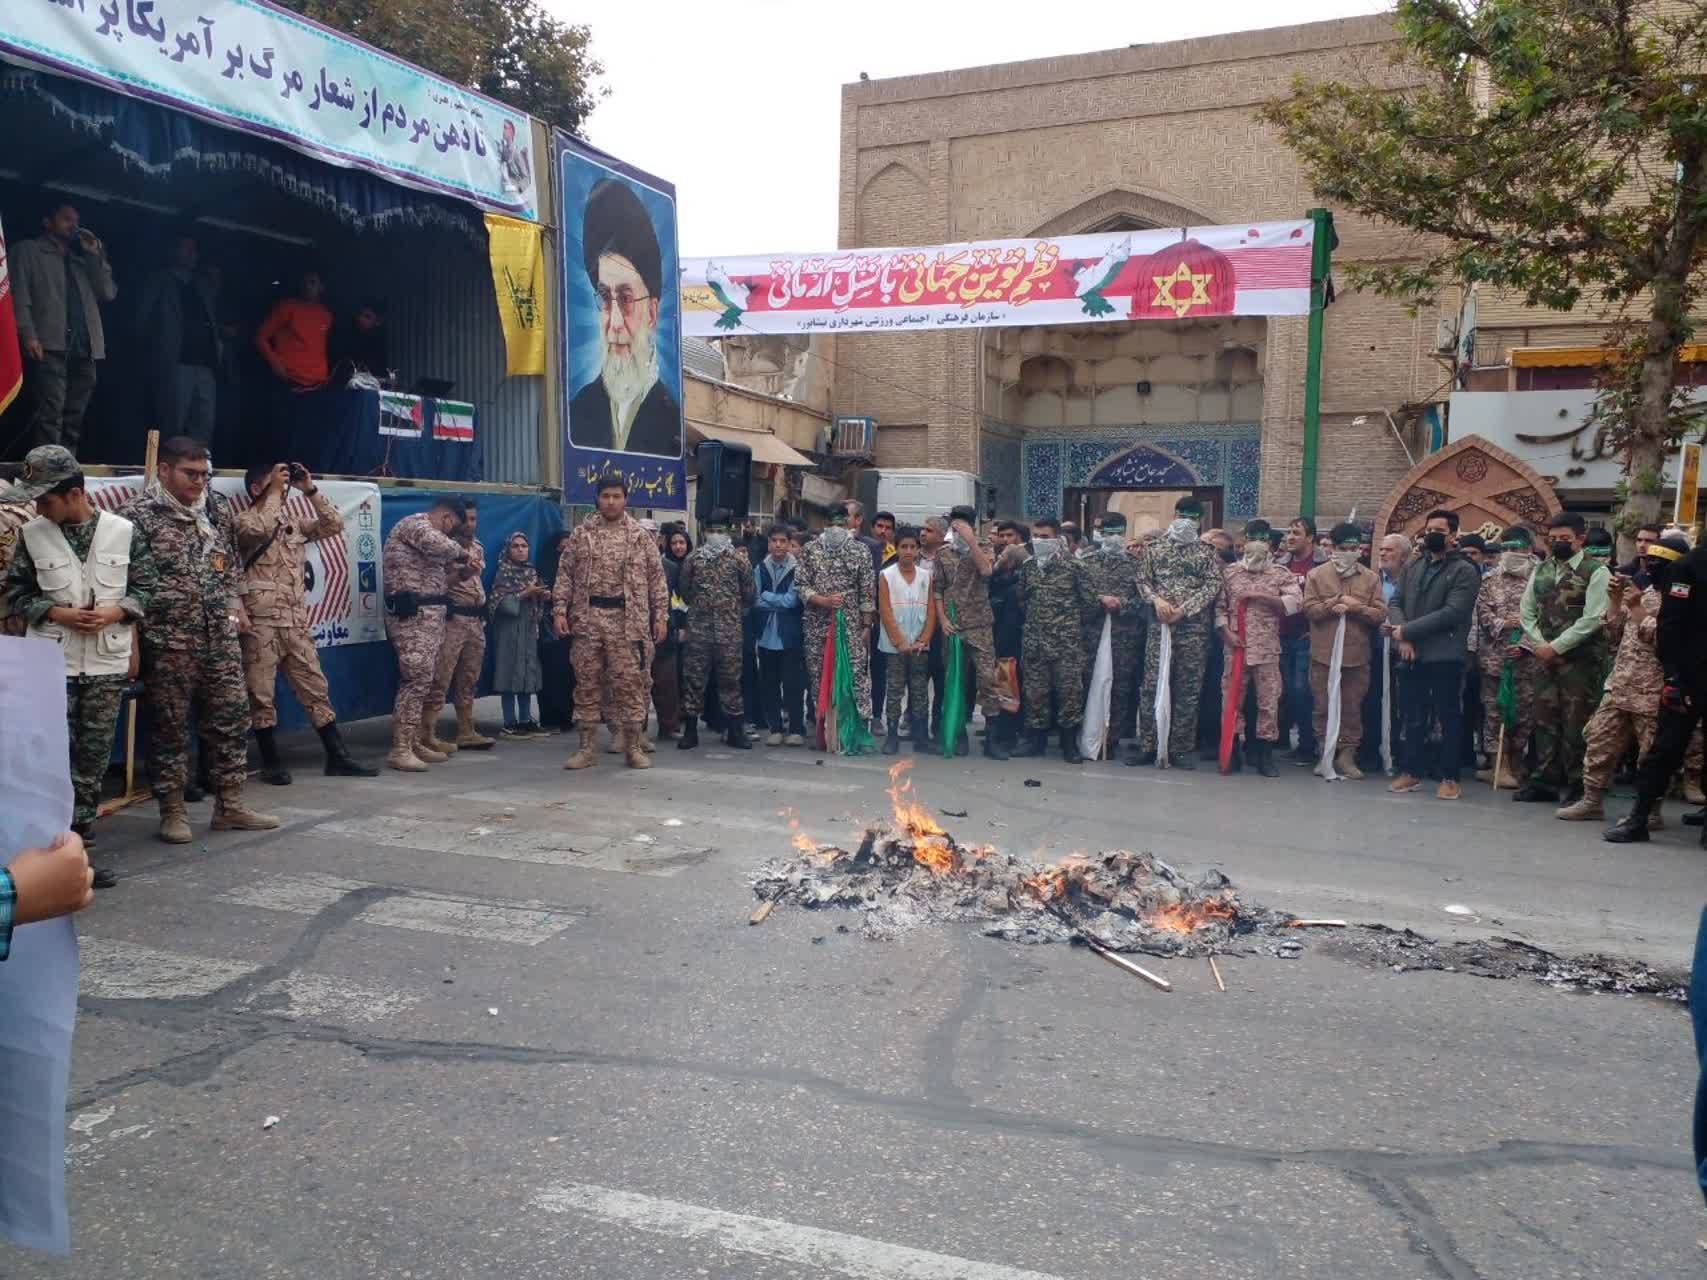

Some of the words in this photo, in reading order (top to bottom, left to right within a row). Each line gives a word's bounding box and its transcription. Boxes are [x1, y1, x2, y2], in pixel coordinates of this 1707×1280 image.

[127, 0, 215, 62] آمریکا
[221, 44, 244, 79] بر
[250, 48, 304, 98] مرگ
[308, 67, 355, 110] شعار
[359, 87, 378, 129] از
[382, 102, 431, 144] مردم
[433, 119, 471, 153] ذهن
[474, 123, 487, 157] تا
[880, 257, 902, 303] با
[899, 251, 971, 303] جهانی
[959, 247, 1026, 309] نوین
[1009, 241, 1060, 307] نظم
[829, 316, 863, 328] شهرداری
[865, 316, 894, 327] ورزشی
[896, 314, 929, 326] اجتماعی
[937, 313, 969, 324] فرهنگی
[971, 311, 1000, 323] سازمان
[1110, 458, 1137, 484] نیشابور
[1134, 463, 1157, 483] جامع
[1156, 462, 1176, 483] مسجد
